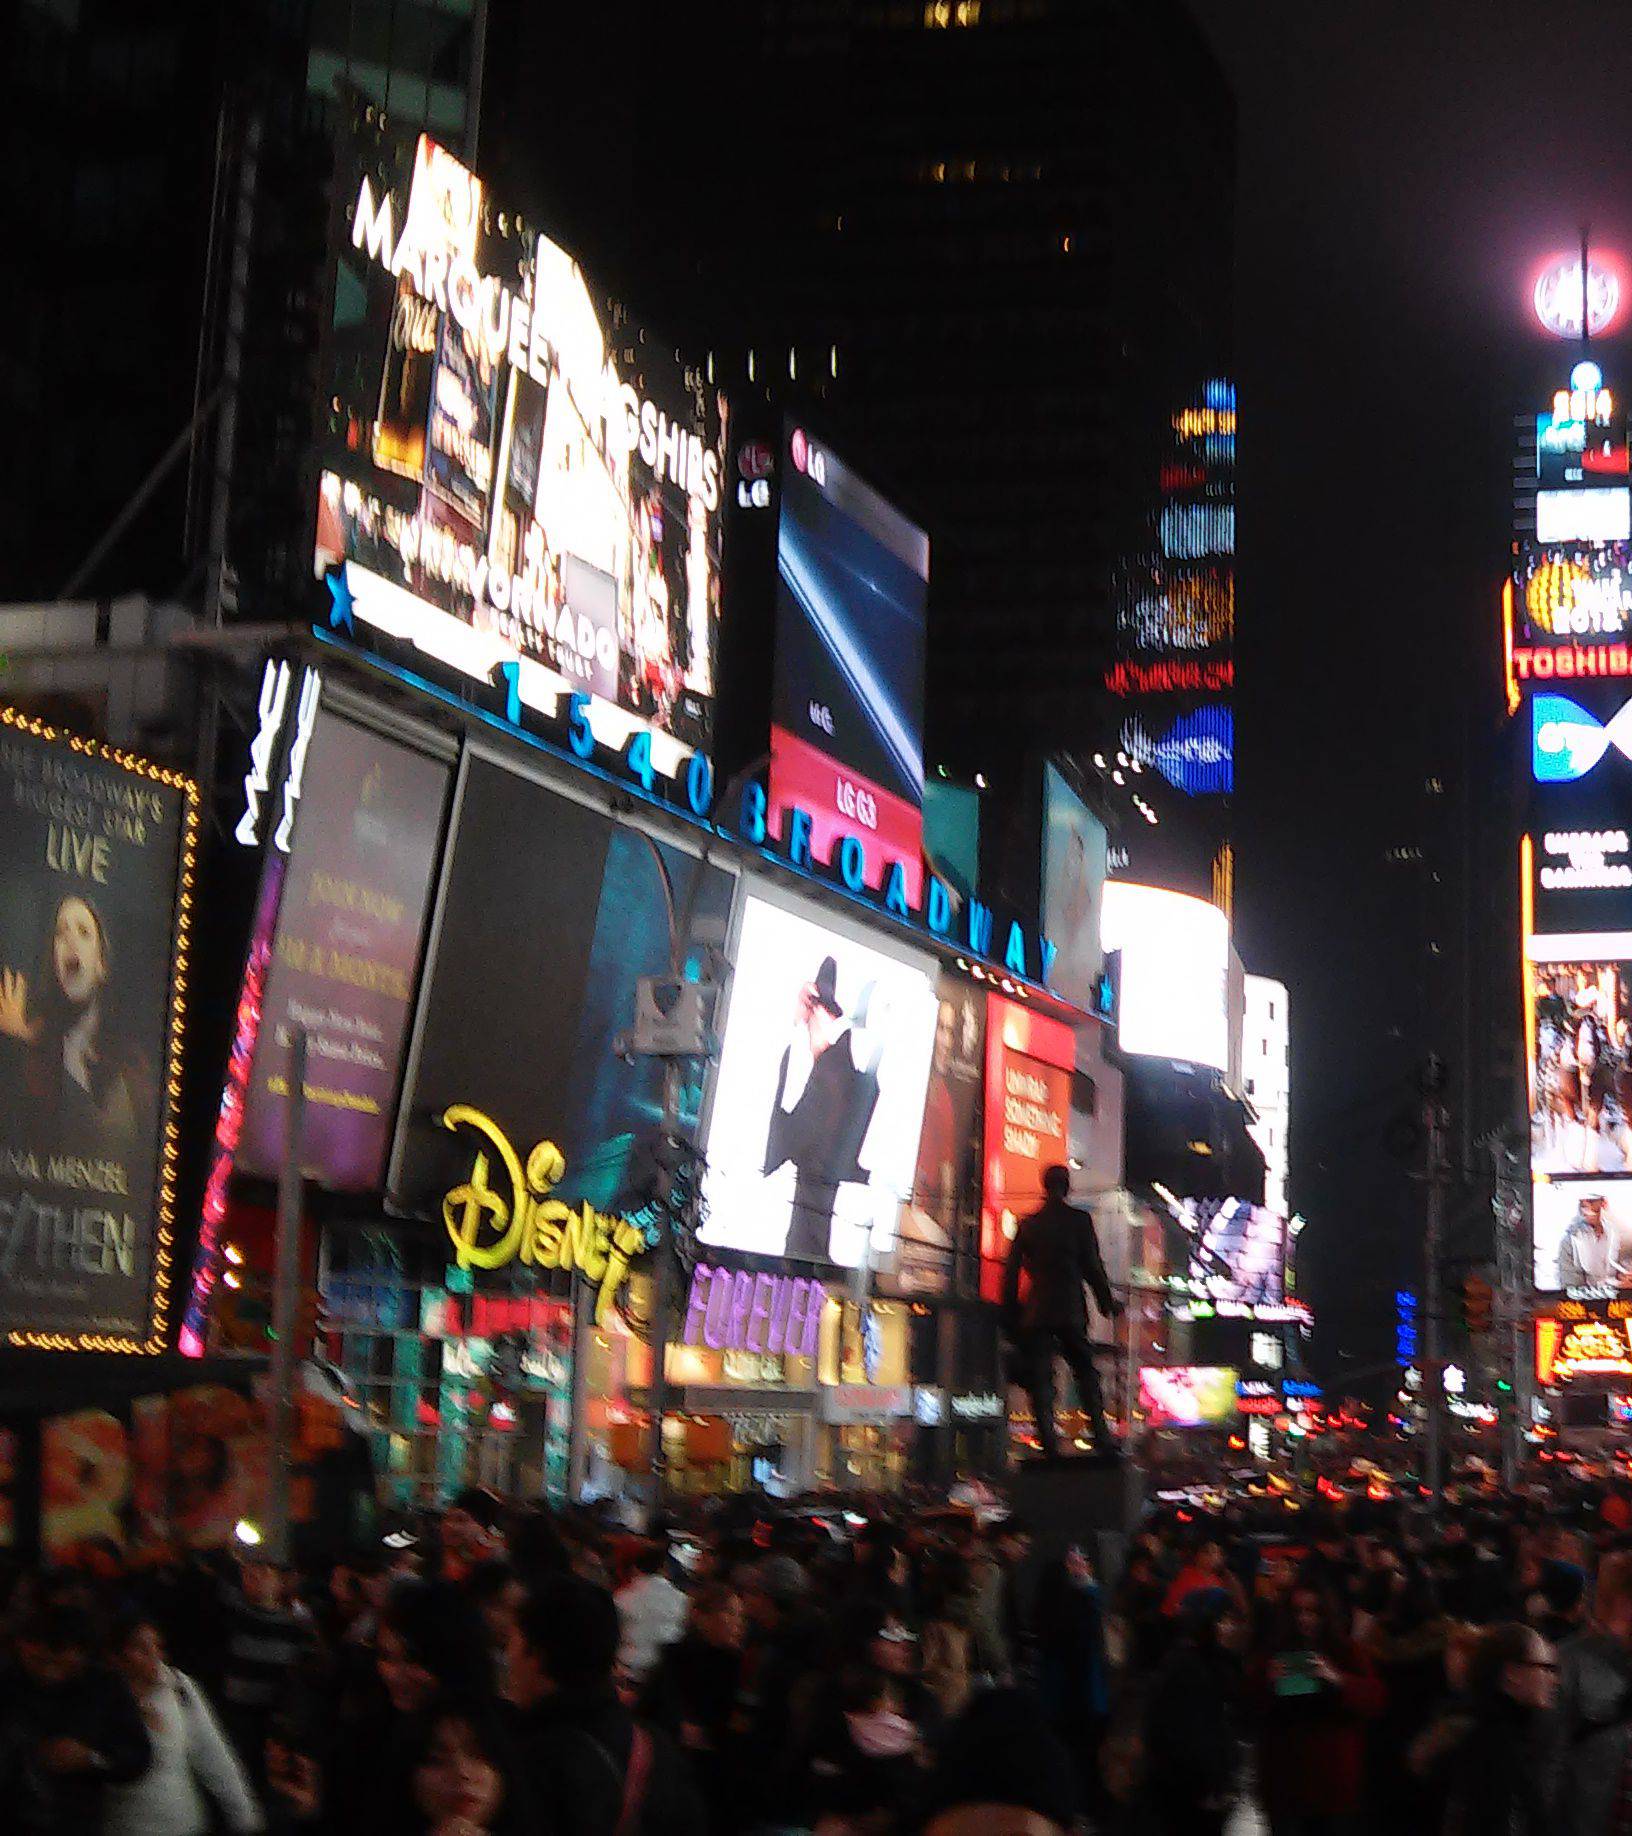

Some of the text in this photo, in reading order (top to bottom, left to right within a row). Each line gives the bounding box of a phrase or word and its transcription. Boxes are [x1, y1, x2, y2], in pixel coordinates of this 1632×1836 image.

[352, 173, 549, 388] MARQUEE
[738, 480, 770, 508] LG
[807, 442, 826, 487] LG
[46, 820, 111, 886] LIVE
[501, 661, 1058, 987] 1540 BROADWAY
